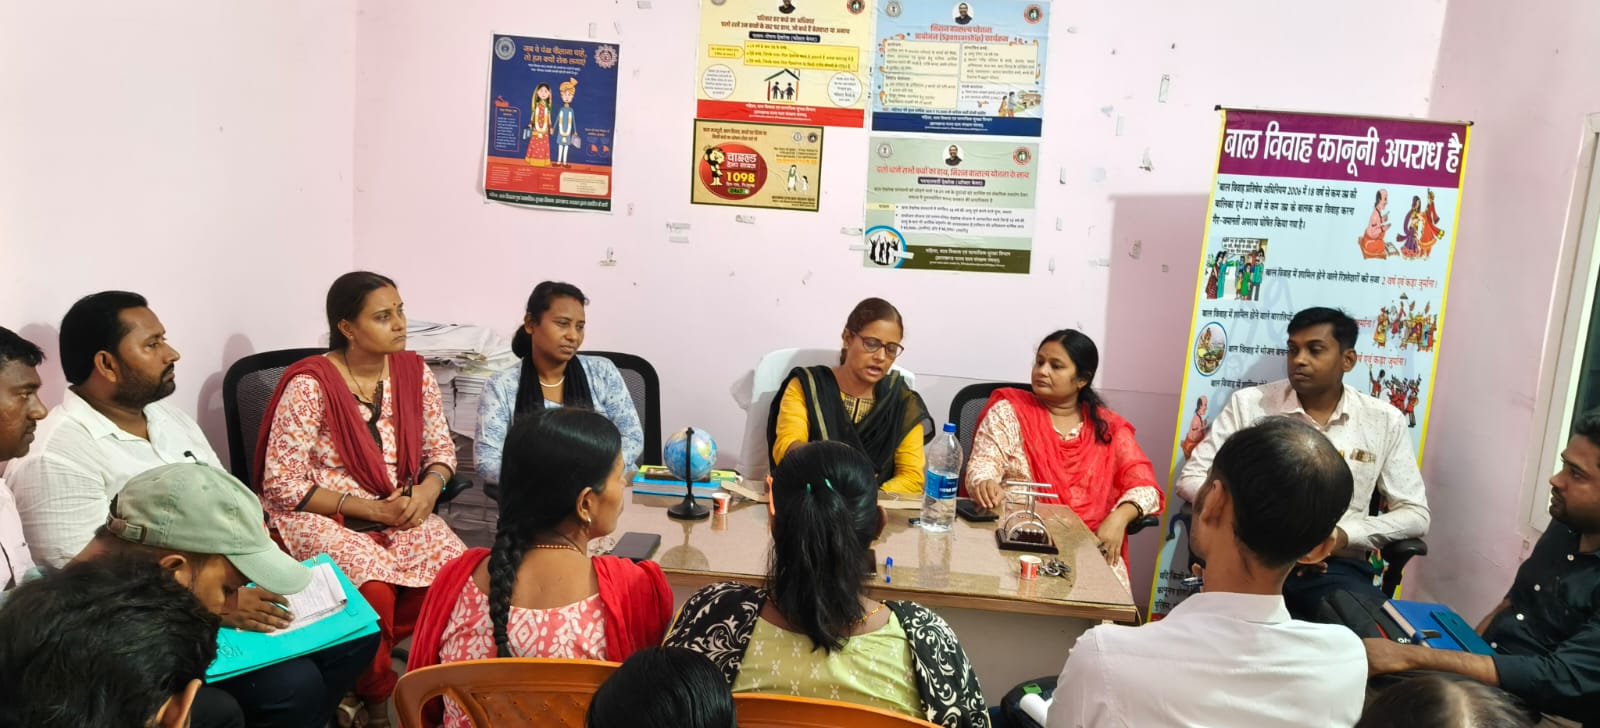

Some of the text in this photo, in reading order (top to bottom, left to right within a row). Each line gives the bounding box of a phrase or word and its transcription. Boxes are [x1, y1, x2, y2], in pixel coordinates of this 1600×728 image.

[1224, 120, 1462, 177] बाल विवाह कानूनी अपराध है
[726, 171, 756, 183] 1098
[1231, 181, 1244, 194] विवाह
[1263, 183, 1287, 194] अधिनियम
[1287, 187, 1301, 196] 2006
[1308, 188, 1315, 196] 18
[1316, 185, 1324, 197] वर्ष
[1324, 186, 1330, 197] से
[1330, 190, 1341, 198] कम
[1215, 197, 1234, 208] बालिका
[1235, 198, 1244, 211] एवं
[1245, 201, 1252, 210] 21
[1253, 199, 1262, 210] वर्ष
[1263, 199, 1270, 210] से
[1270, 202, 1279, 210] कम
[1290, 200, 1296, 212] के
[1298, 204, 1313, 213] बालक
[1315, 204, 1323, 213] का
[1324, 202, 1340, 216] विवाह
[1241, 217, 1258, 226] अपराध
[1274, 216, 1289, 228] किया
[1289, 220, 1299, 229] गया
[1265, 268, 1277, 277] बाल
[1277, 266, 1292, 278] विवाह
[1298, 268, 1316, 280] शामिल
[1316, 269, 1326, 280] होने
[1326, 270, 1337, 280] वाले
[1361, 272, 1369, 283] को
[1387, 274, 1396, 285] वर्ष
[1213, 308, 1228, 320] विवाह
[1228, 345, 1239, 353] बाल
[1239, 344, 1254, 356] विवाह
[1211, 379, 1221, 387] बाल
[1221, 377, 1235, 389] विवाह
